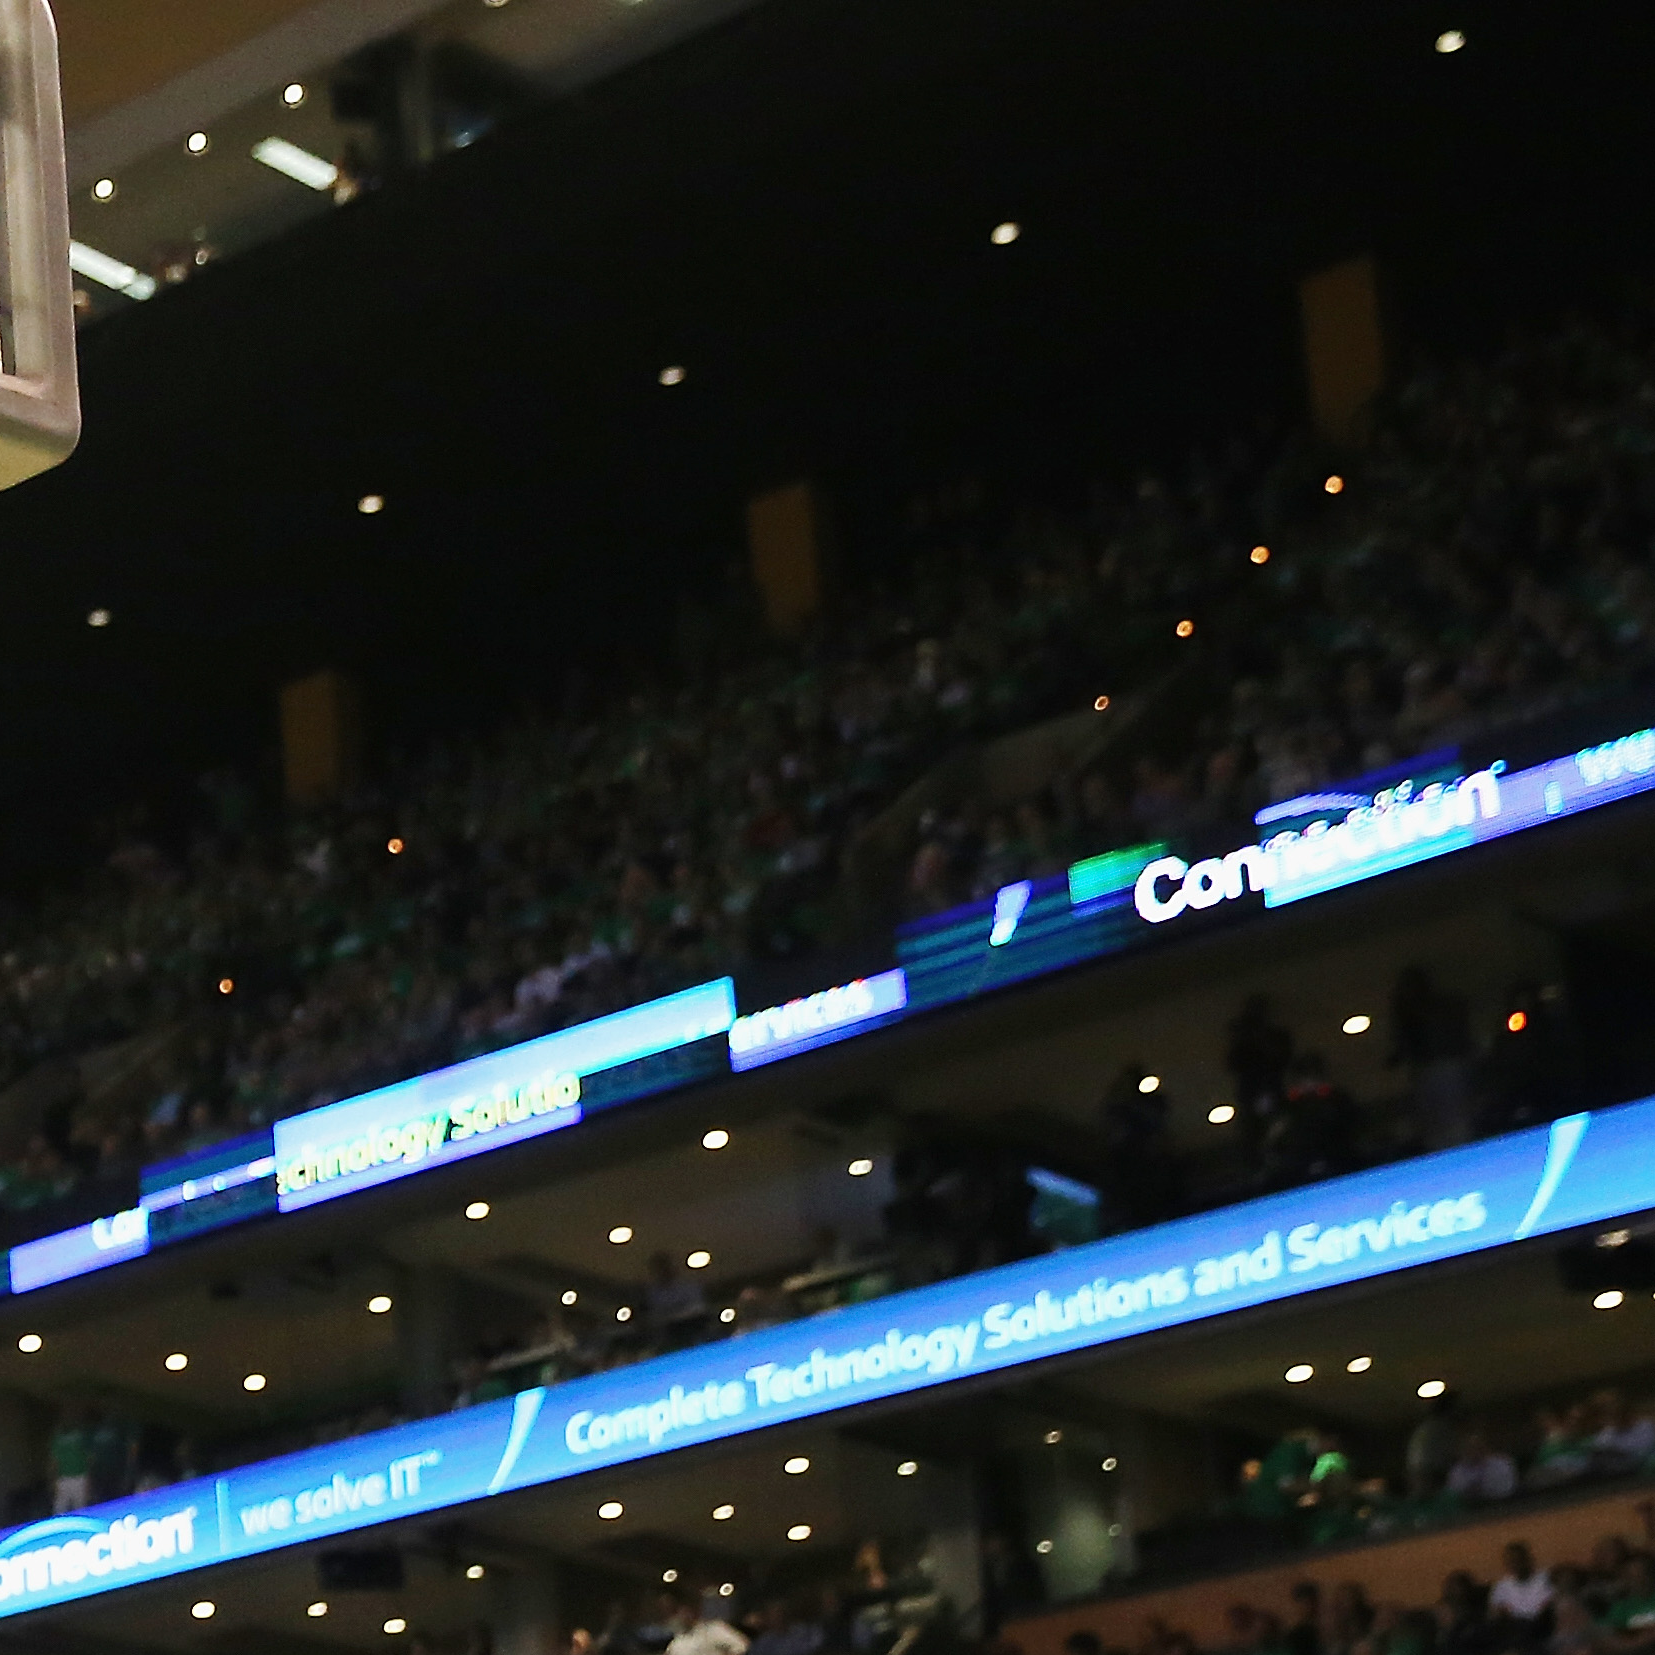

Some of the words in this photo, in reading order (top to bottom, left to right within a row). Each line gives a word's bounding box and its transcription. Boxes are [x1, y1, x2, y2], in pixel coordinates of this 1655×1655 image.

[564, 1379, 747, 1455] Complete
[746, 1319, 981, 1408] Technology
[983, 1265, 1191, 1349] Solutions
[1194, 1230, 1285, 1297] and
[1287, 1190, 1487, 1272] Services
[240, 1499, 292, 1537] we
[294, 1472, 386, 1524] solve
